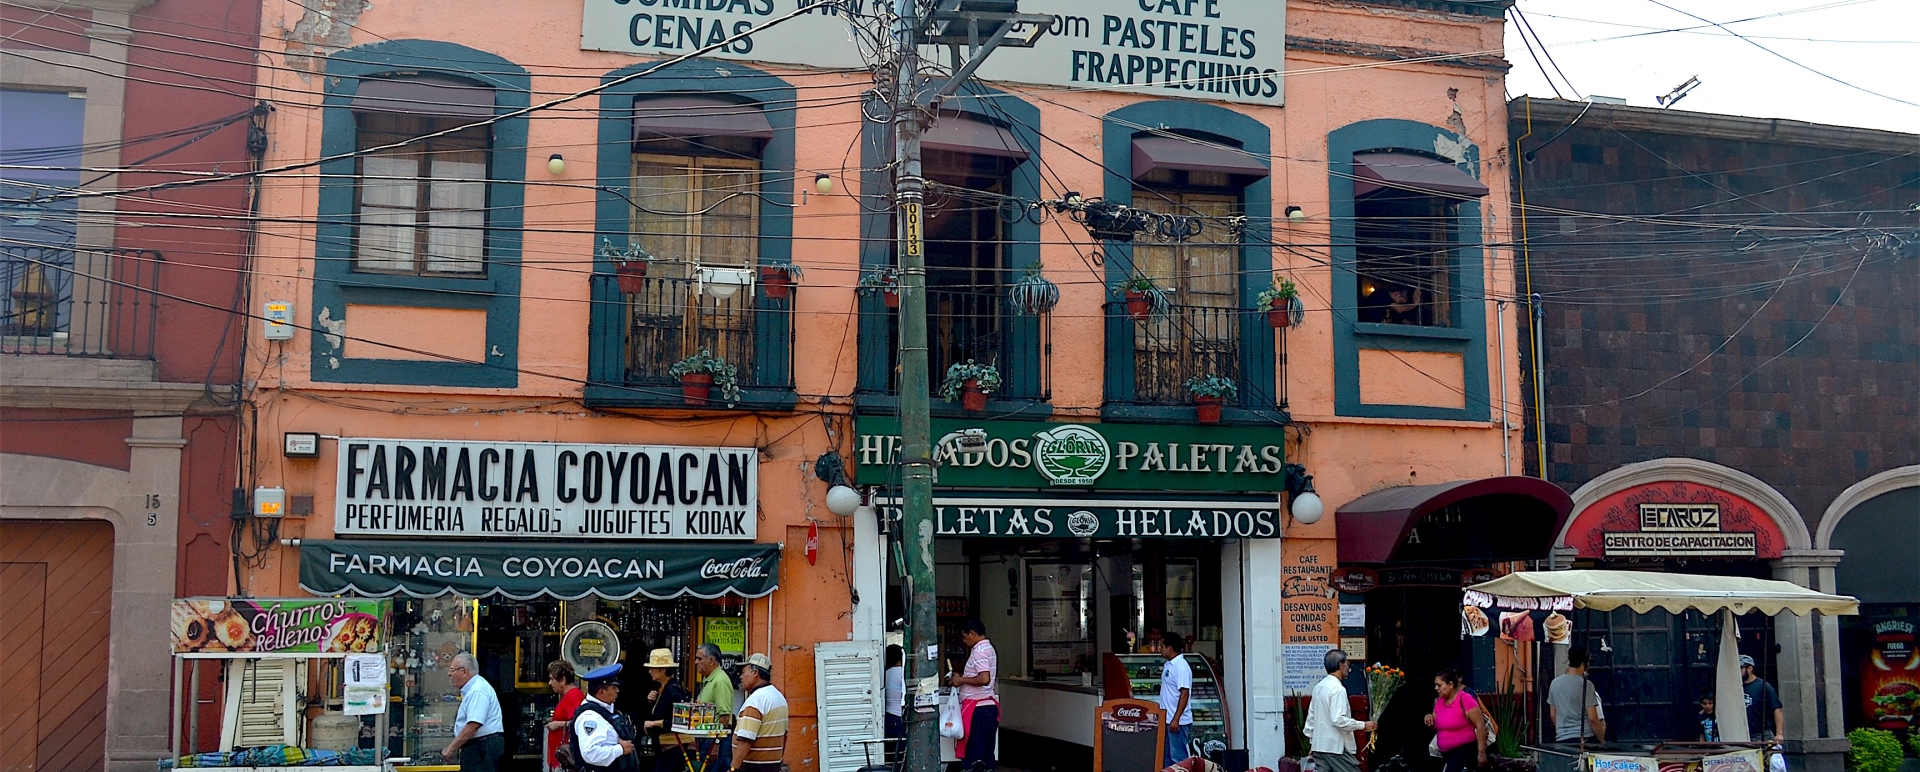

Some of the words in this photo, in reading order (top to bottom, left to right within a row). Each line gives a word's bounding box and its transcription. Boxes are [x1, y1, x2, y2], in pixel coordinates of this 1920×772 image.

[629, 13, 755, 55] CENAS
[1102, 14, 1256, 60] PASTELES
[1071, 50, 1279, 98] FRAPPECHINOS
[1046, 439, 1101, 454] GLORIA
[1115, 441, 1283, 474] PALETAS
[346, 443, 540, 503] FARMACIA
[556, 449, 749, 506] COYOACAN
[345, 504, 465, 532] PERFUMERIA
[481, 507, 562, 533] REGALOS
[686, 510, 747, 536] KODAK
[880, 506, 1055, 536] PLETAS
[1115, 508, 1275, 537] HELADOS
[1605, 536, 1655, 548] CENTRO
[1655, 537, 1671, 548] DE
[1671, 537, 1754, 548] CAPACITACION
[329, 553, 485, 578] FARMACIA
[501, 557, 664, 579] COYOACAN
[1299, 555, 1318, 564] CAFE
[251, 600, 345, 635] Churros
[1283, 602, 1333, 612] DESAYUNOS
[1290, 612, 1327, 622] COMIDAS
[255, 623, 332, 653] Rellenos
[1295, 623, 1322, 633] CENAS
